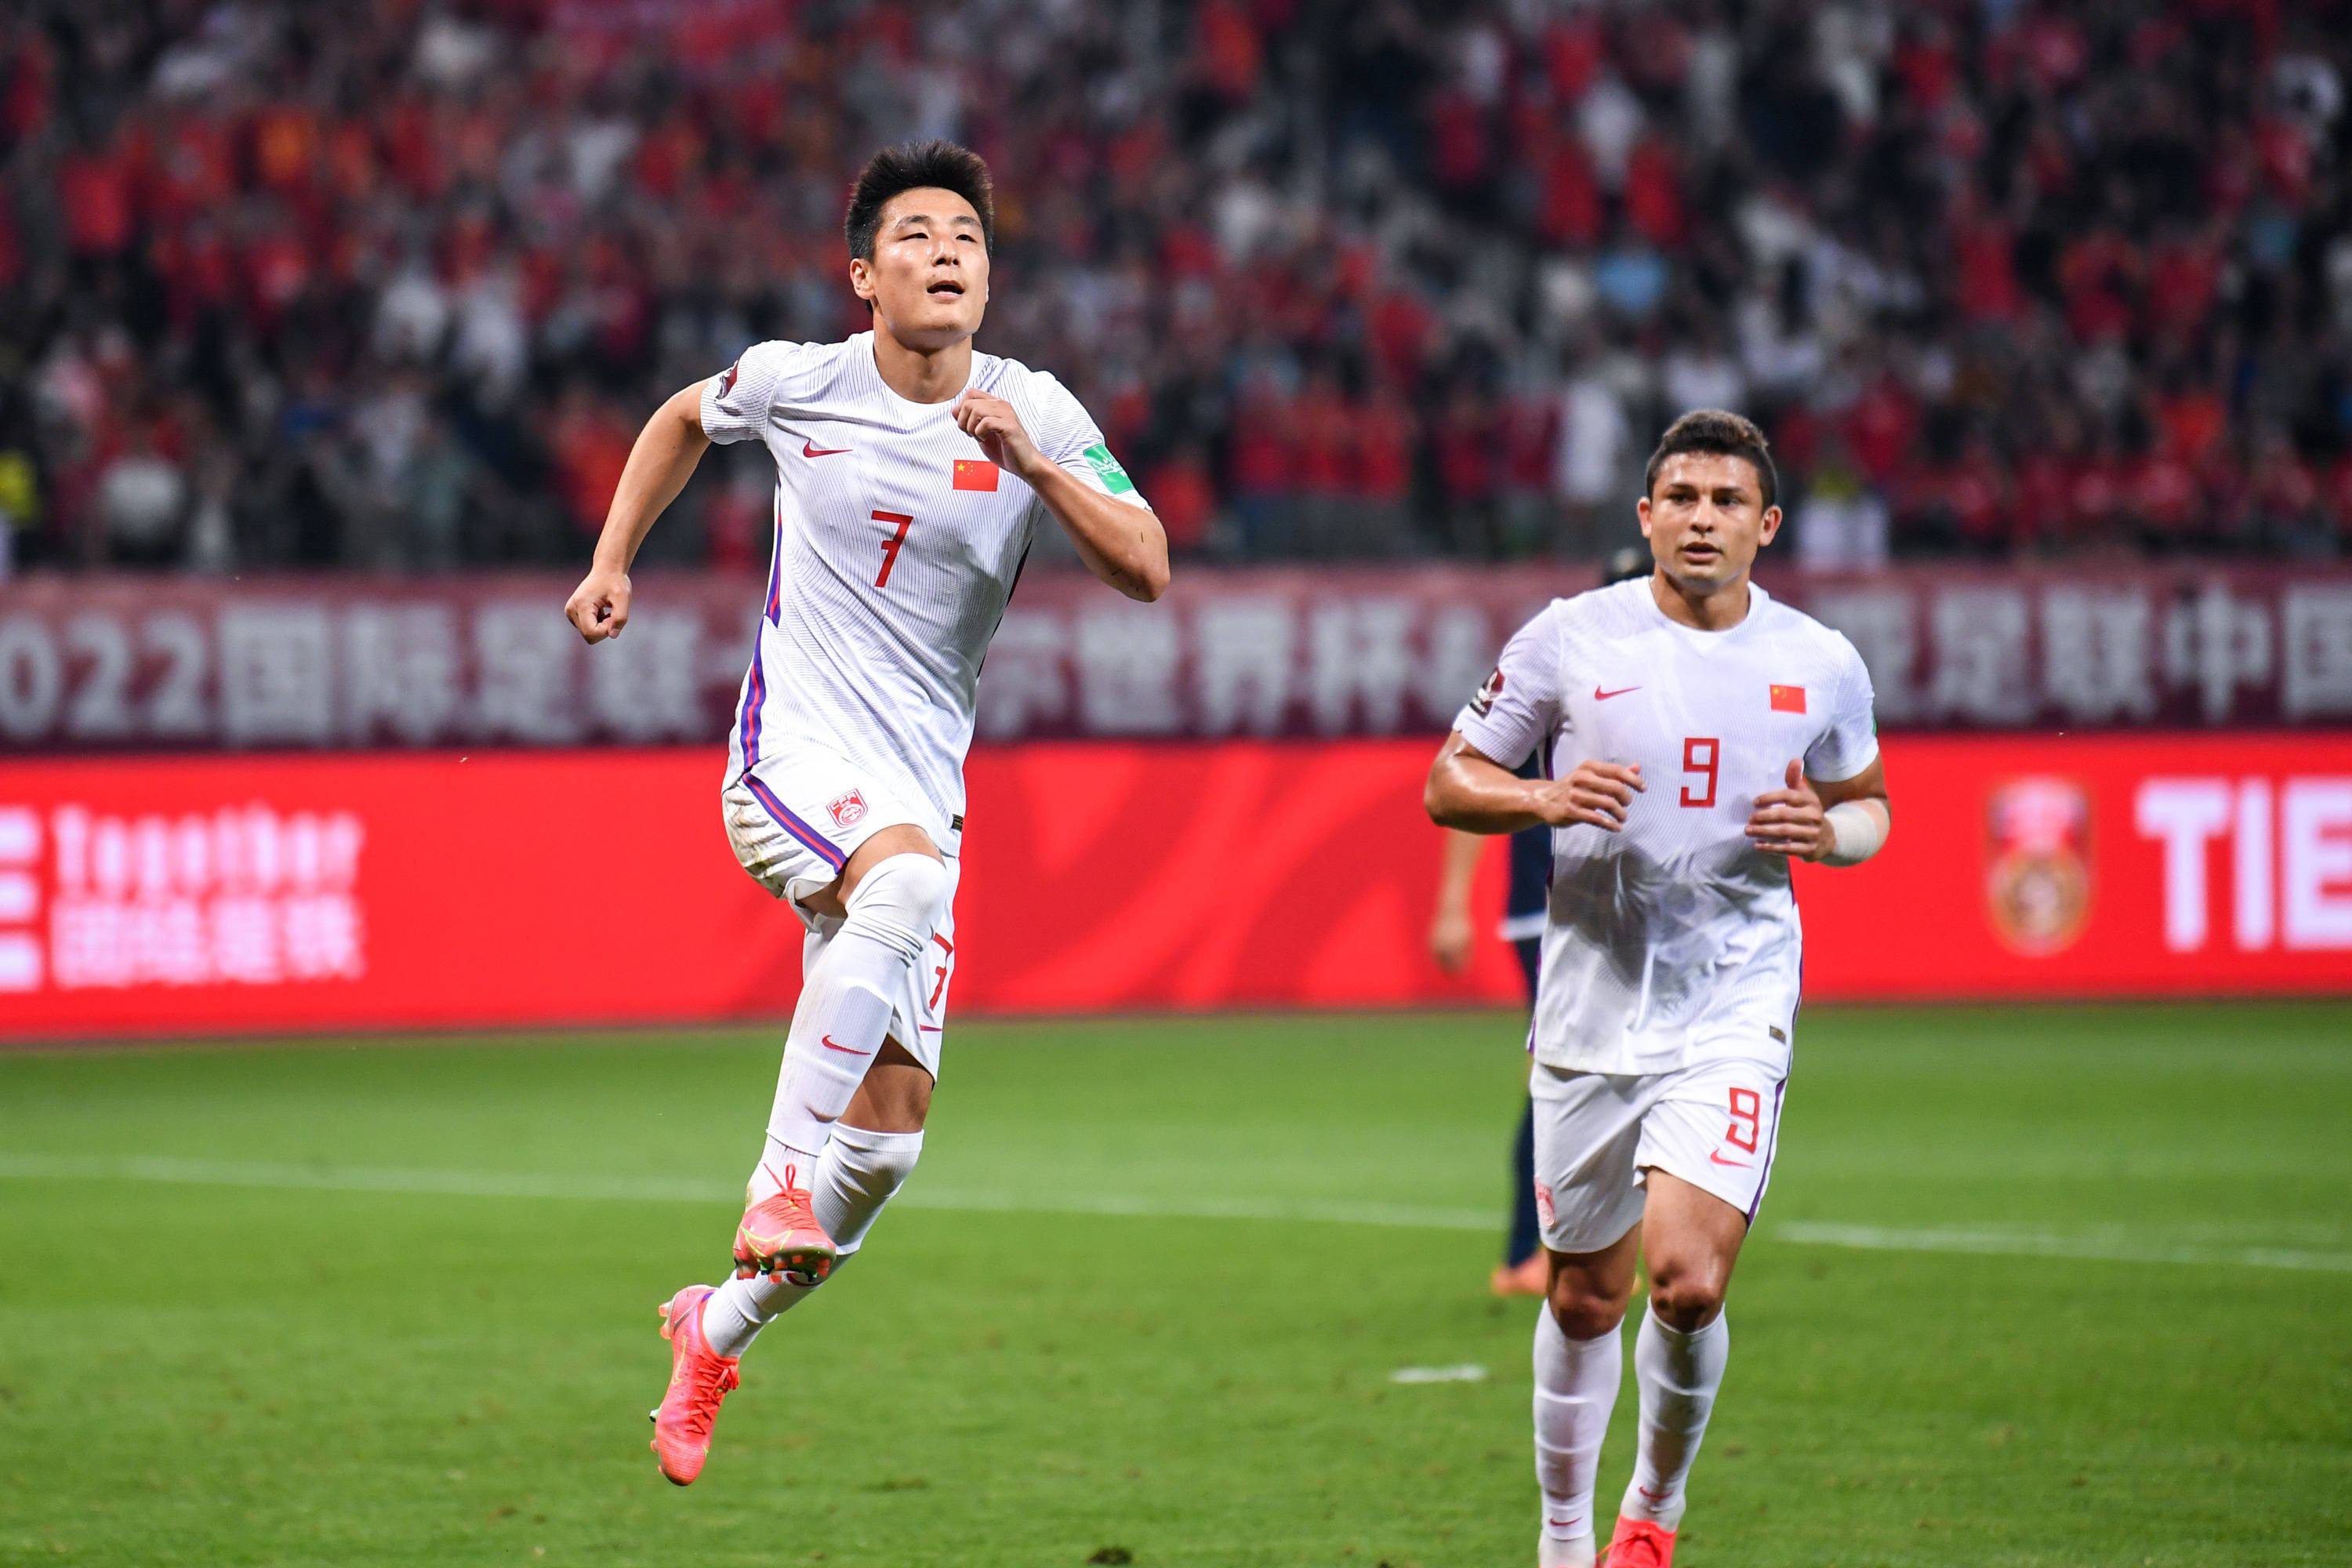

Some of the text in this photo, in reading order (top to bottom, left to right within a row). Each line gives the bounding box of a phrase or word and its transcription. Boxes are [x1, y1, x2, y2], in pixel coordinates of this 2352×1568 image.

[871, 510, 913, 587] 7
[1680, 738, 1719, 808] 9
[929, 932, 954, 1011] 7
[1726, 1087, 1760, 1155] 9
